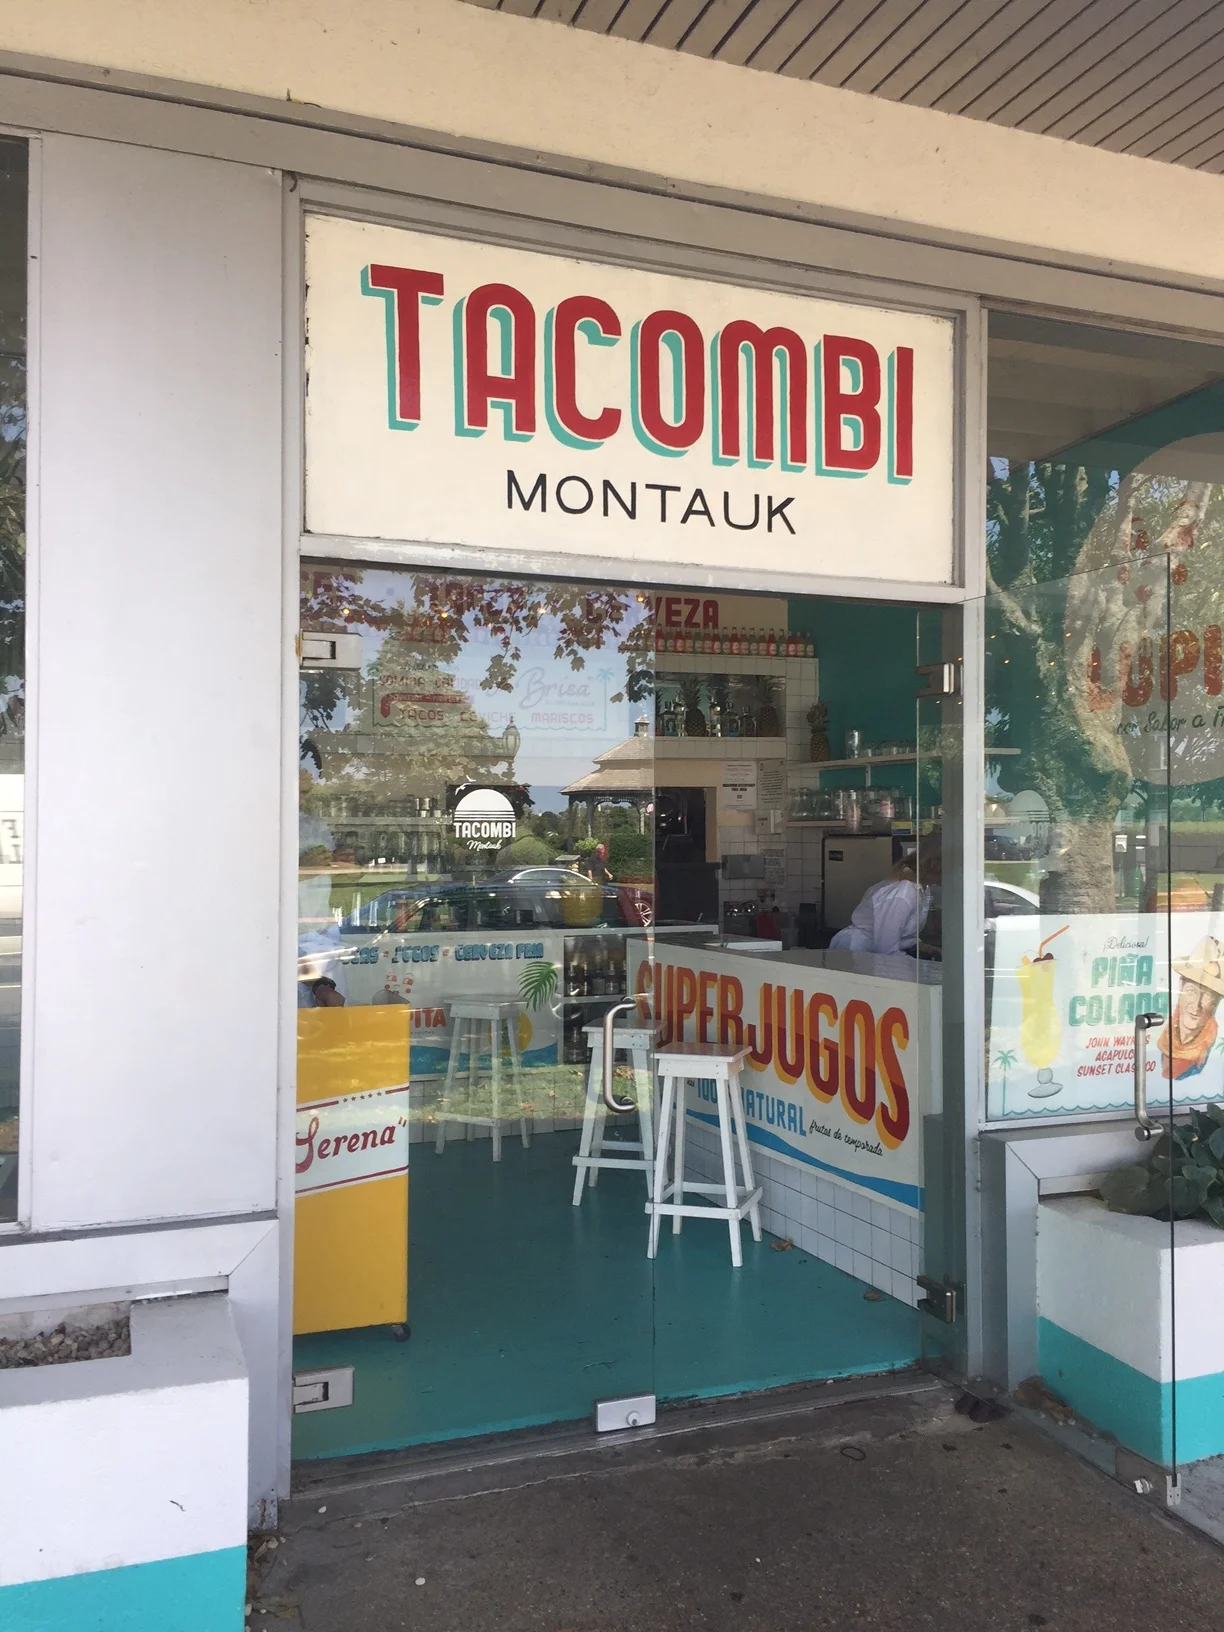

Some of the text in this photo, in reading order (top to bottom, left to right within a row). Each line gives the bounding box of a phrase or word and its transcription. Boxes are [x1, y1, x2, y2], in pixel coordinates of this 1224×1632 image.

[361, 264, 914, 484] TACOMBI
[507, 470, 796, 534] MONTAUK
[531, 712, 595, 724] MARISCOS
[453, 822, 516, 838] TACOMBI
[455, 943, 513, 962] CERVEZA
[1091, 953, 1153, 988] PIÑA
[636, 960, 910, 1150] SUPER JUGOS
[1086, 1036, 1109, 1048] JOHN
[1077, 1064, 1113, 1077] SUNSET
[809, 1119, 884, 1156] frutas de temporada
